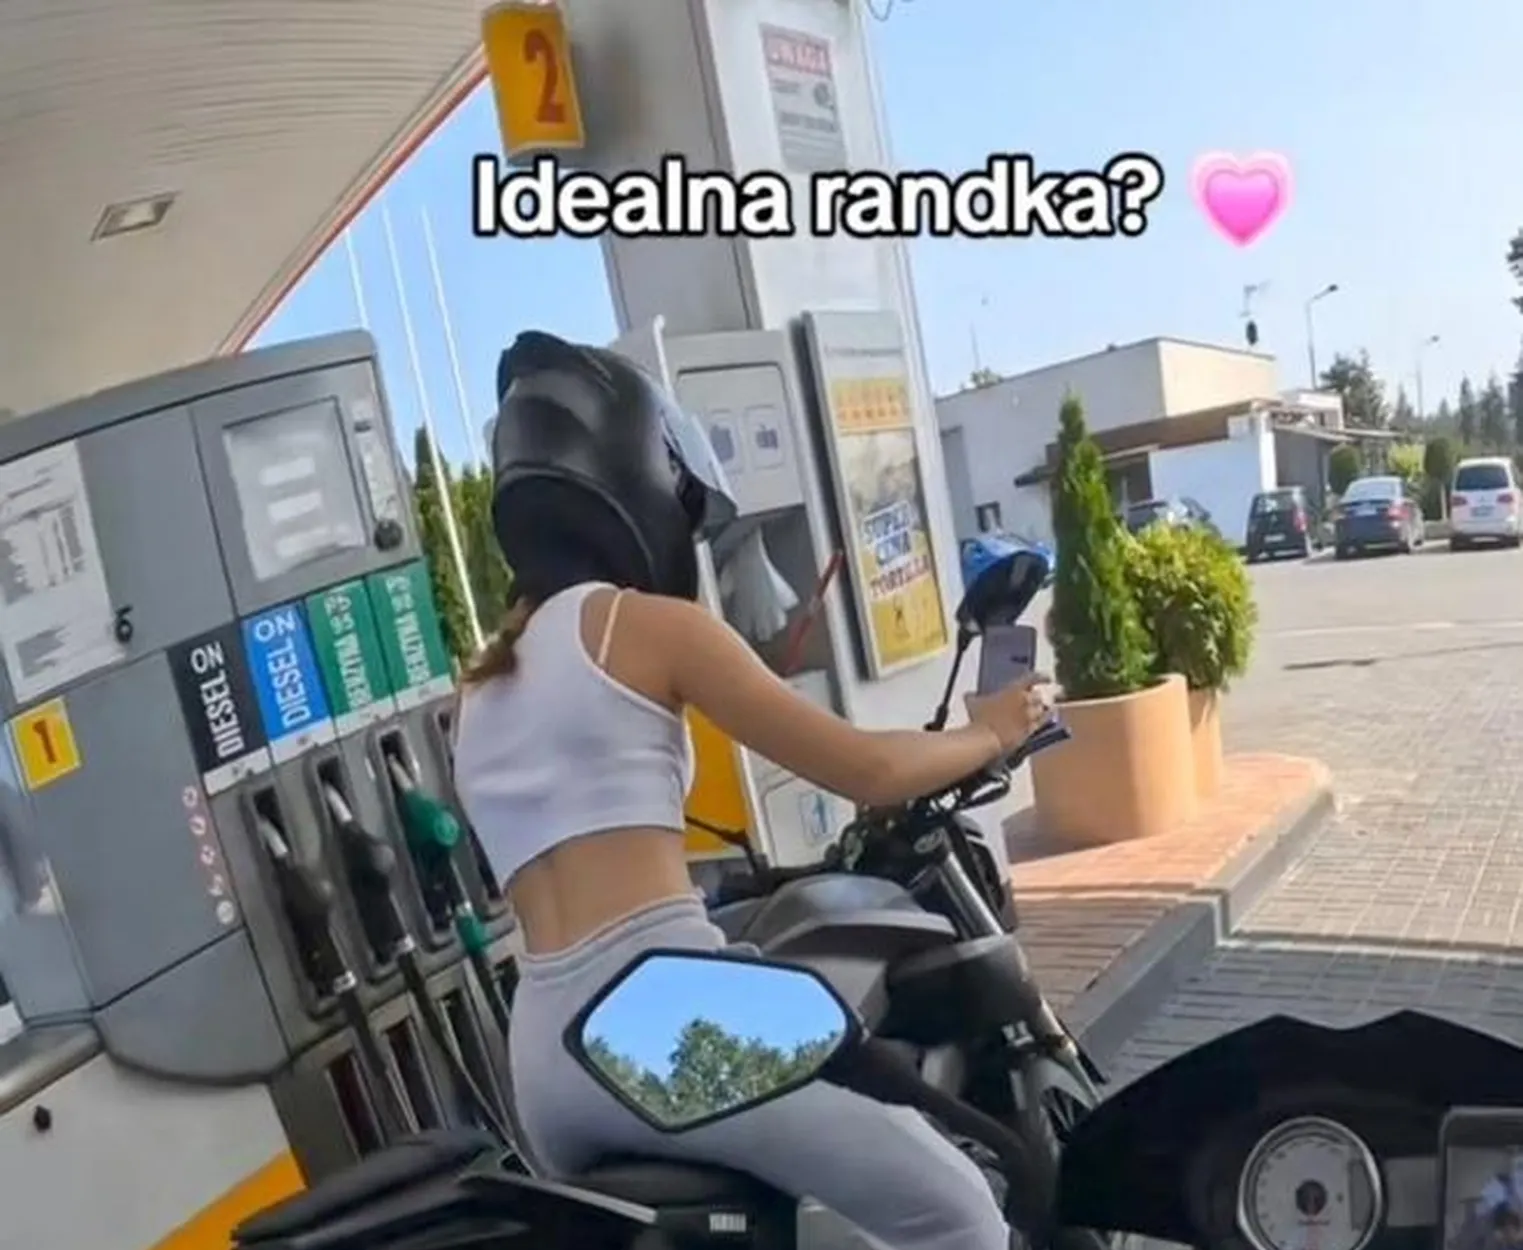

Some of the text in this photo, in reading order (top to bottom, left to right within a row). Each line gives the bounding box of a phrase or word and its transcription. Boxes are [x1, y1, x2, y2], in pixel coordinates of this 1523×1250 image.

[523, 28, 566, 123] 2
[190, 640, 225, 674] ON
[254, 610, 296, 643] ON
[200, 669, 245, 758] DIESEL
[266, 636, 312, 729] DIESEL
[32, 719, 57, 764] 1
